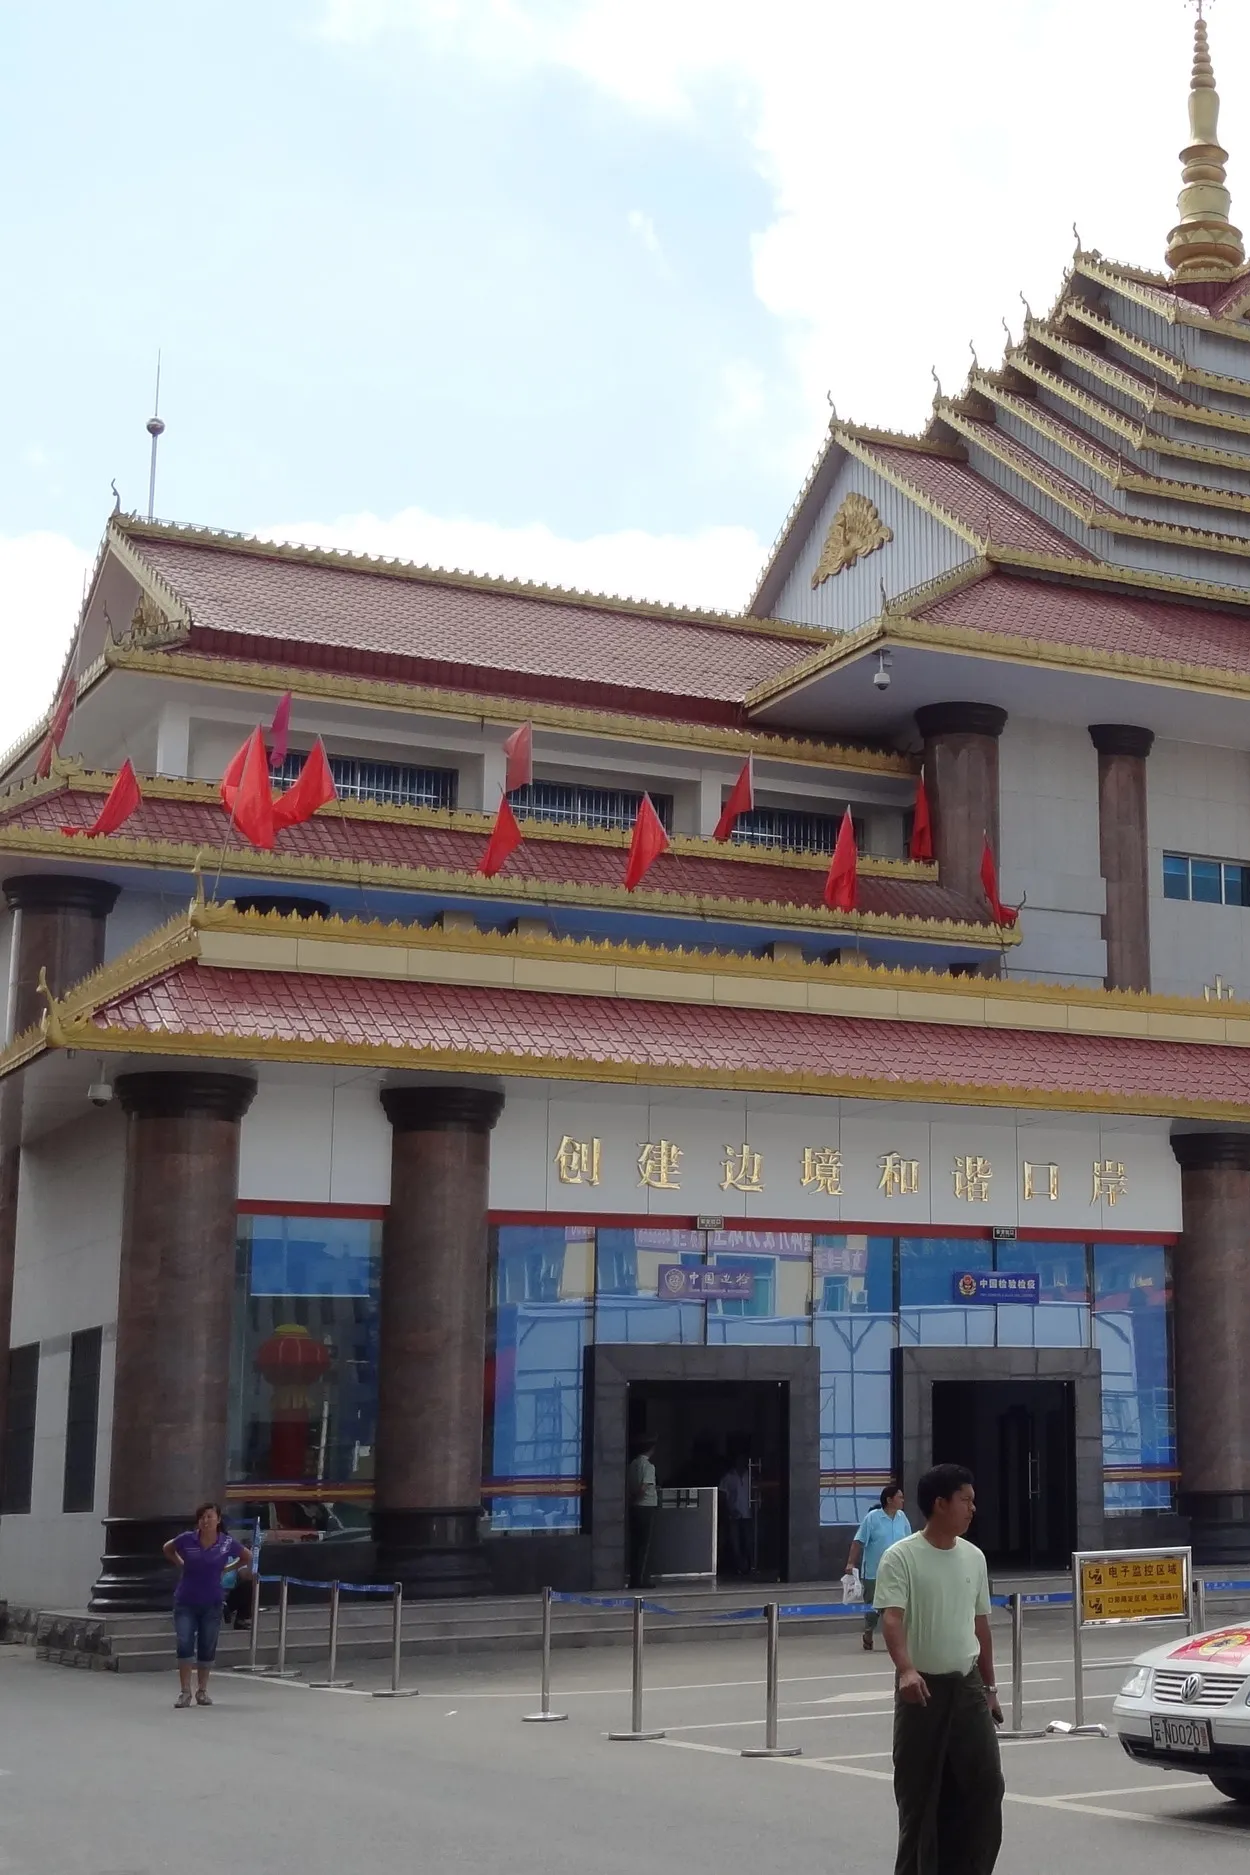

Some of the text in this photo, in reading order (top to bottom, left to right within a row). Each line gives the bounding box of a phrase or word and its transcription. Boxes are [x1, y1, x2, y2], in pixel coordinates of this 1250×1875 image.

[553, 1134, 1127, 1207] 创建边境和谐口岸
[688, 1269, 750, 1287] 中国边检
[979, 1277, 1036, 1290] 中国检验检疫
[1108, 1563, 1177, 1579] 电子监控区域
